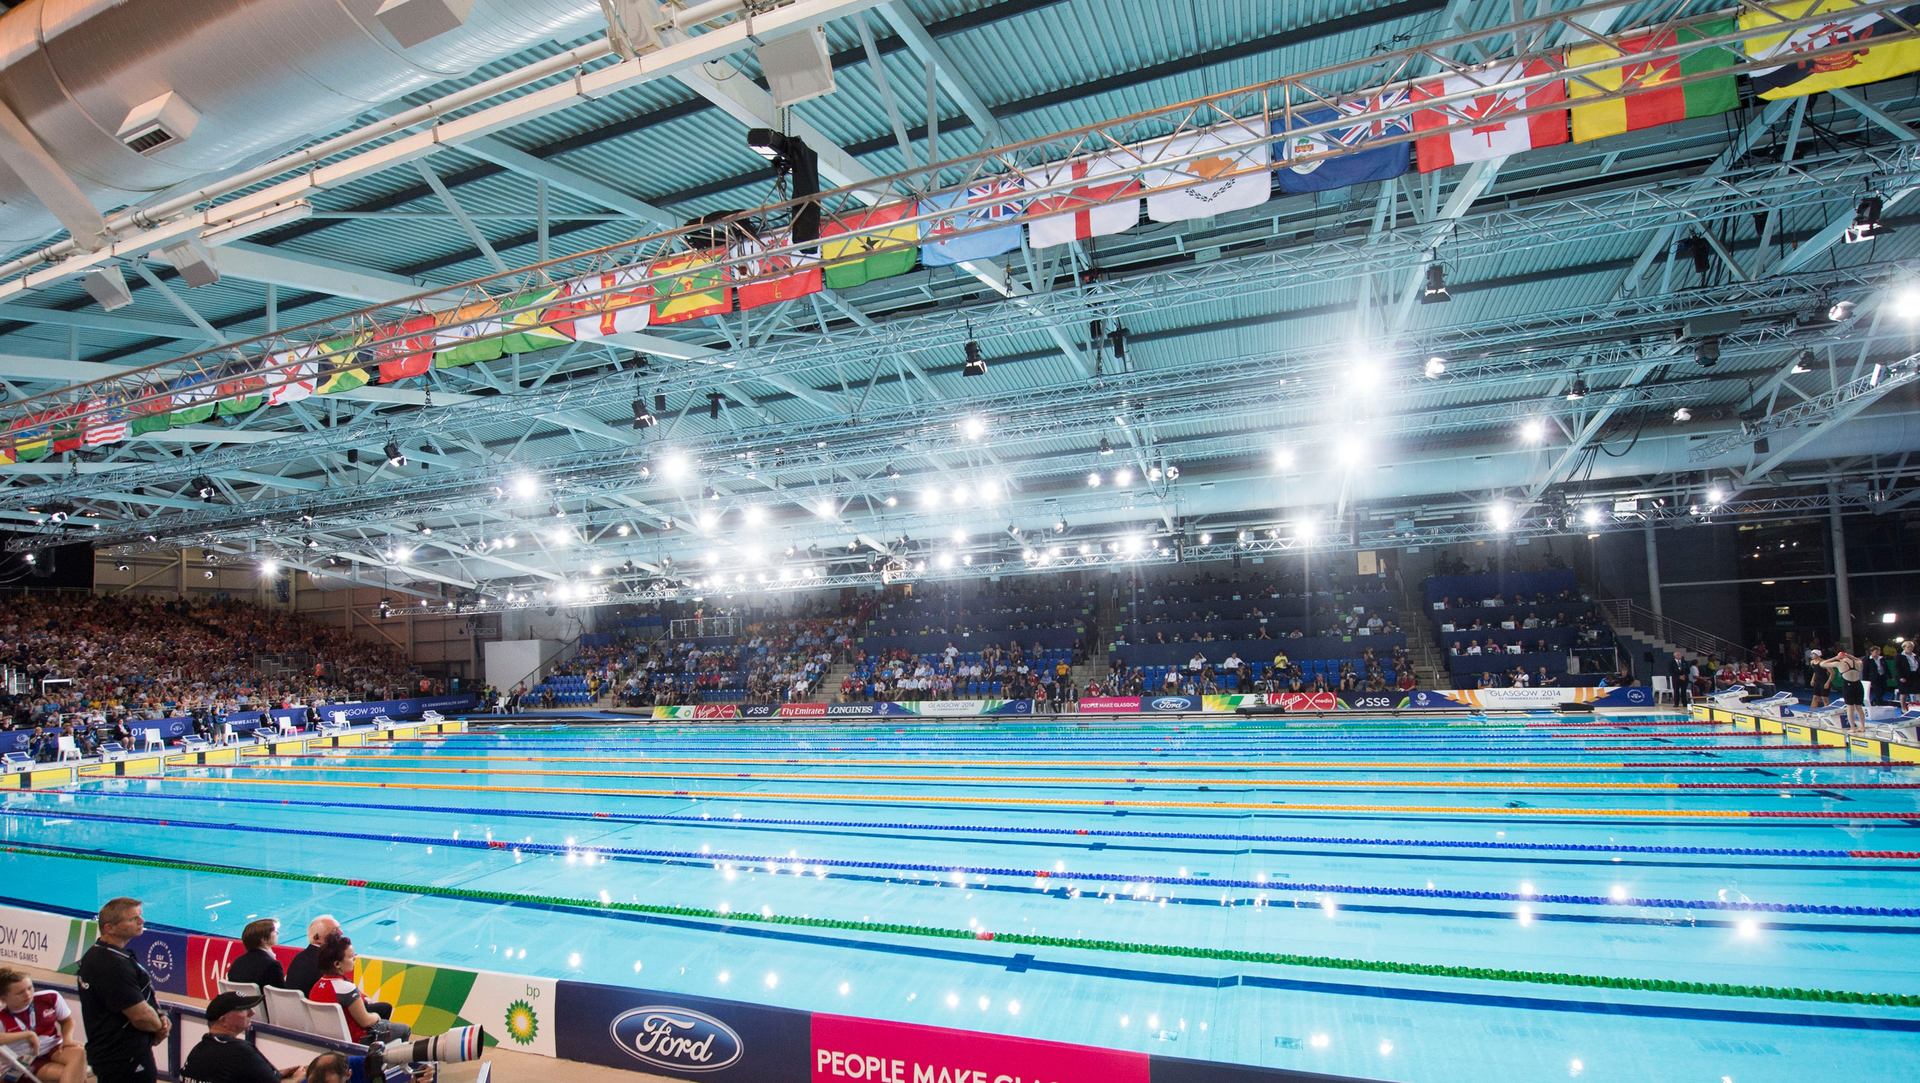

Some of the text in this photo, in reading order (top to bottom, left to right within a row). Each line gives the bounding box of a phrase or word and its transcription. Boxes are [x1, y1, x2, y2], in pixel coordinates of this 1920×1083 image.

[1489, 689, 1538, 697] GLASGOW
[1158, 699, 1184, 709] Ford
[1366, 697, 1390, 707] sse
[328, 708, 368, 718] GSGOW
[753, 706, 769, 714] sse
[781, 708, 794, 716] Fly
[827, 706, 874, 714] LONGINES
[22, 929, 48, 952] 2014
[19, 951, 39, 963] GAMES
[526, 983, 541, 1000] bp
[635, 1014, 716, 1063] Ford
[817, 1048, 905, 1083] PEOPLE
